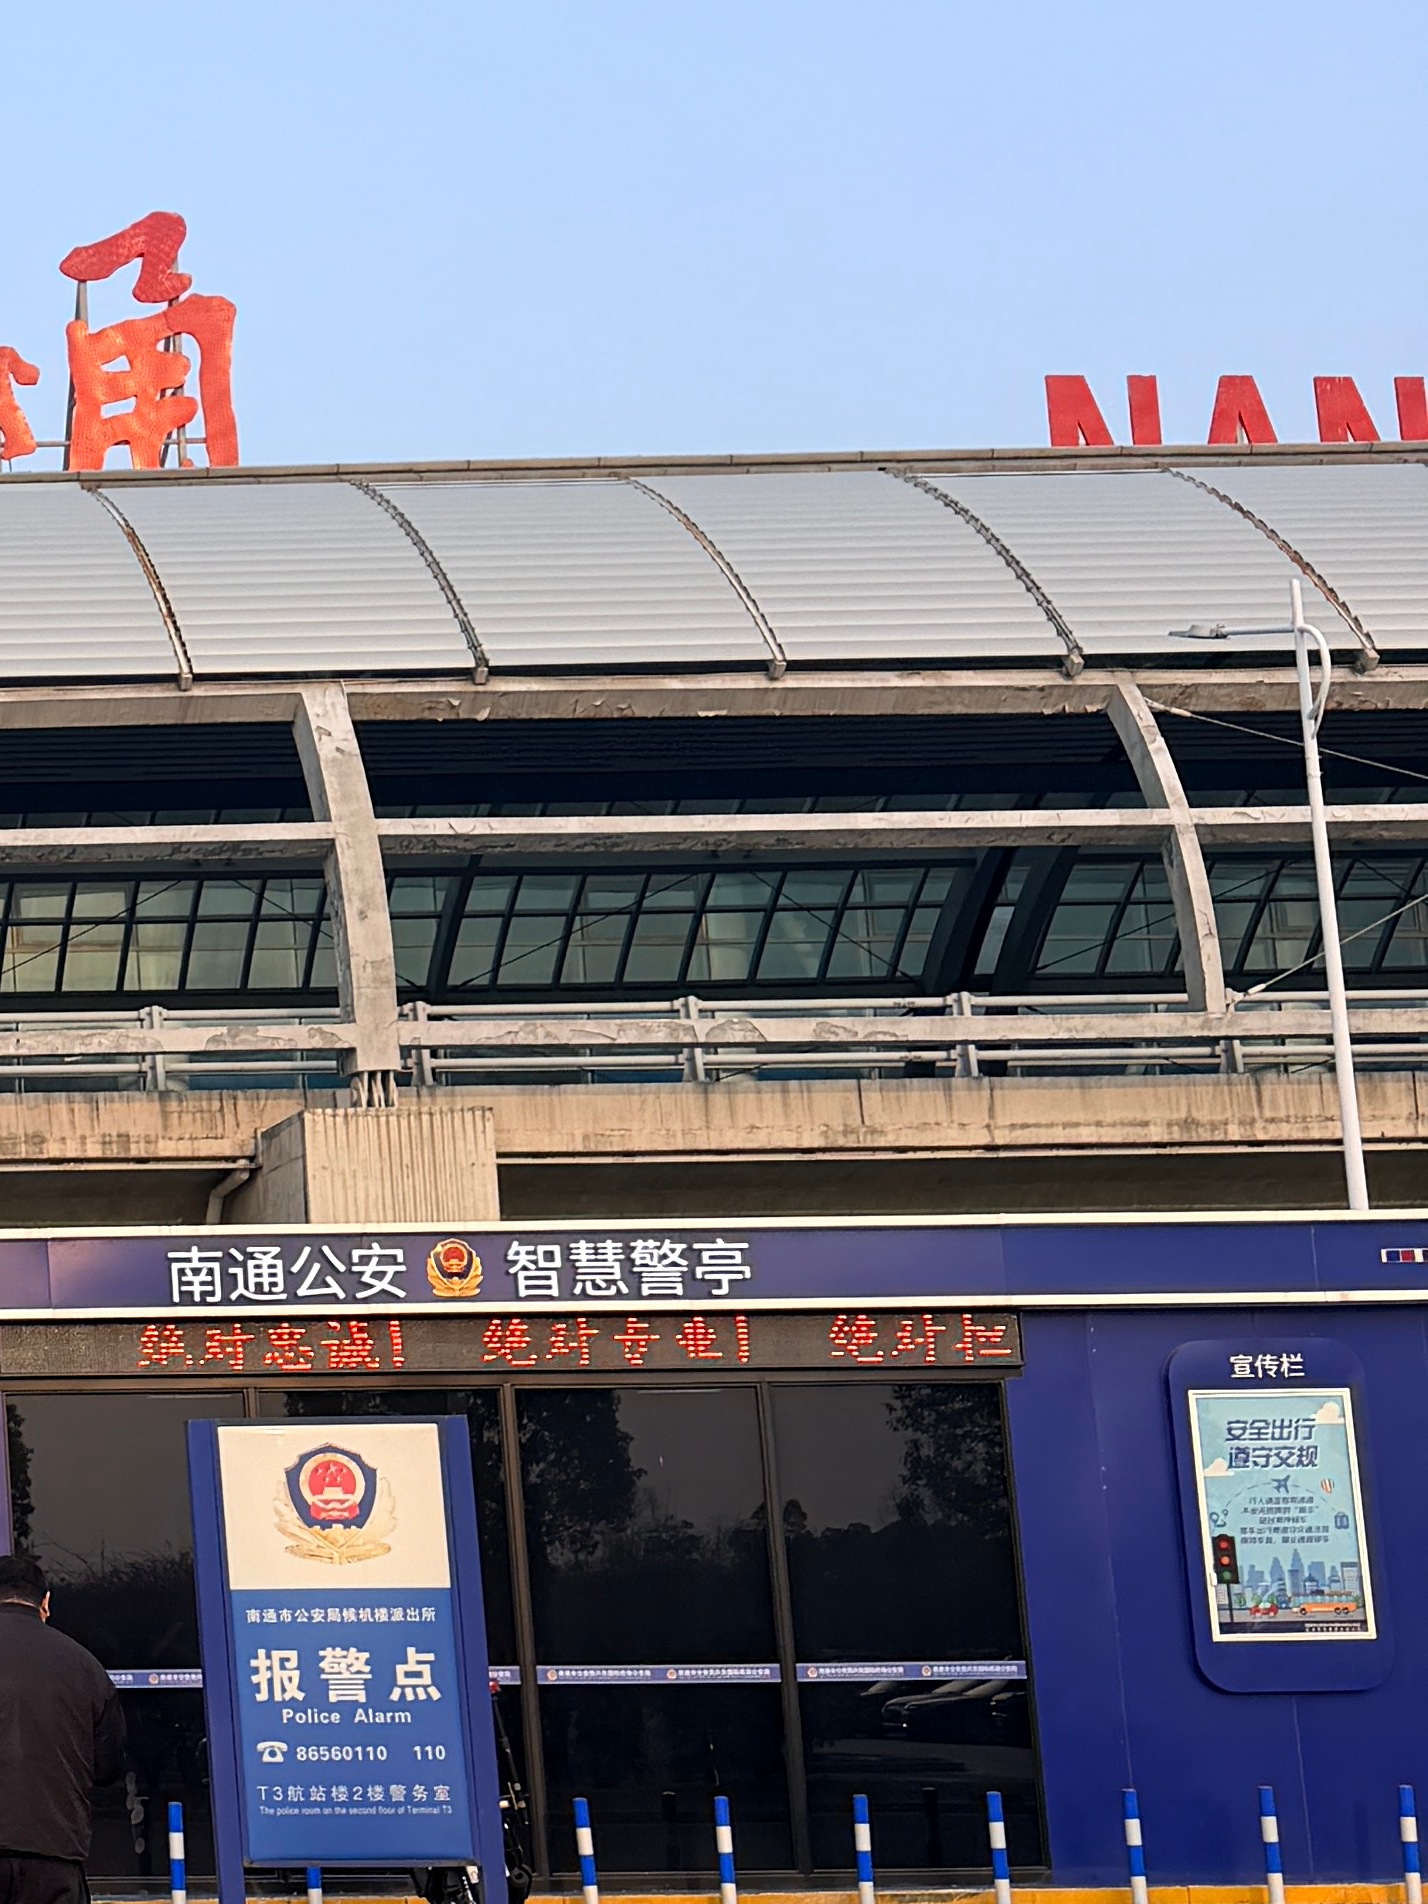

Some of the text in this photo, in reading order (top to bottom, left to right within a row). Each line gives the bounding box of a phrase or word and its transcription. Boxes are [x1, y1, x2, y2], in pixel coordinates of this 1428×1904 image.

[167, 1238, 752, 1303] 南通公安 智慧警亭
[1229, 1353, 1305, 1378] 宣传栏
[1225, 1418, 1316, 1441] 安全出行
[1227, 1446, 1318, 1469] 遵守交规
[245, 1607, 436, 1623] 南通市公安局候机楼派出所
[250, 1646, 441, 1703] 报警点
[282, 1708, 412, 1724] Police Alarm
[296, 1745, 446, 1761] 86560110 110
[257, 1784, 451, 1802] T3航站楼2楼警务室
[260, 1805, 274, 1815] The
[276, 1806, 299, 1816] police
[349, 1806, 376, 1815] second
[378, 1806, 395, 1814] floor
[397, 1806, 405, 1814] of
[407, 1805, 440, 1814] Terminal
